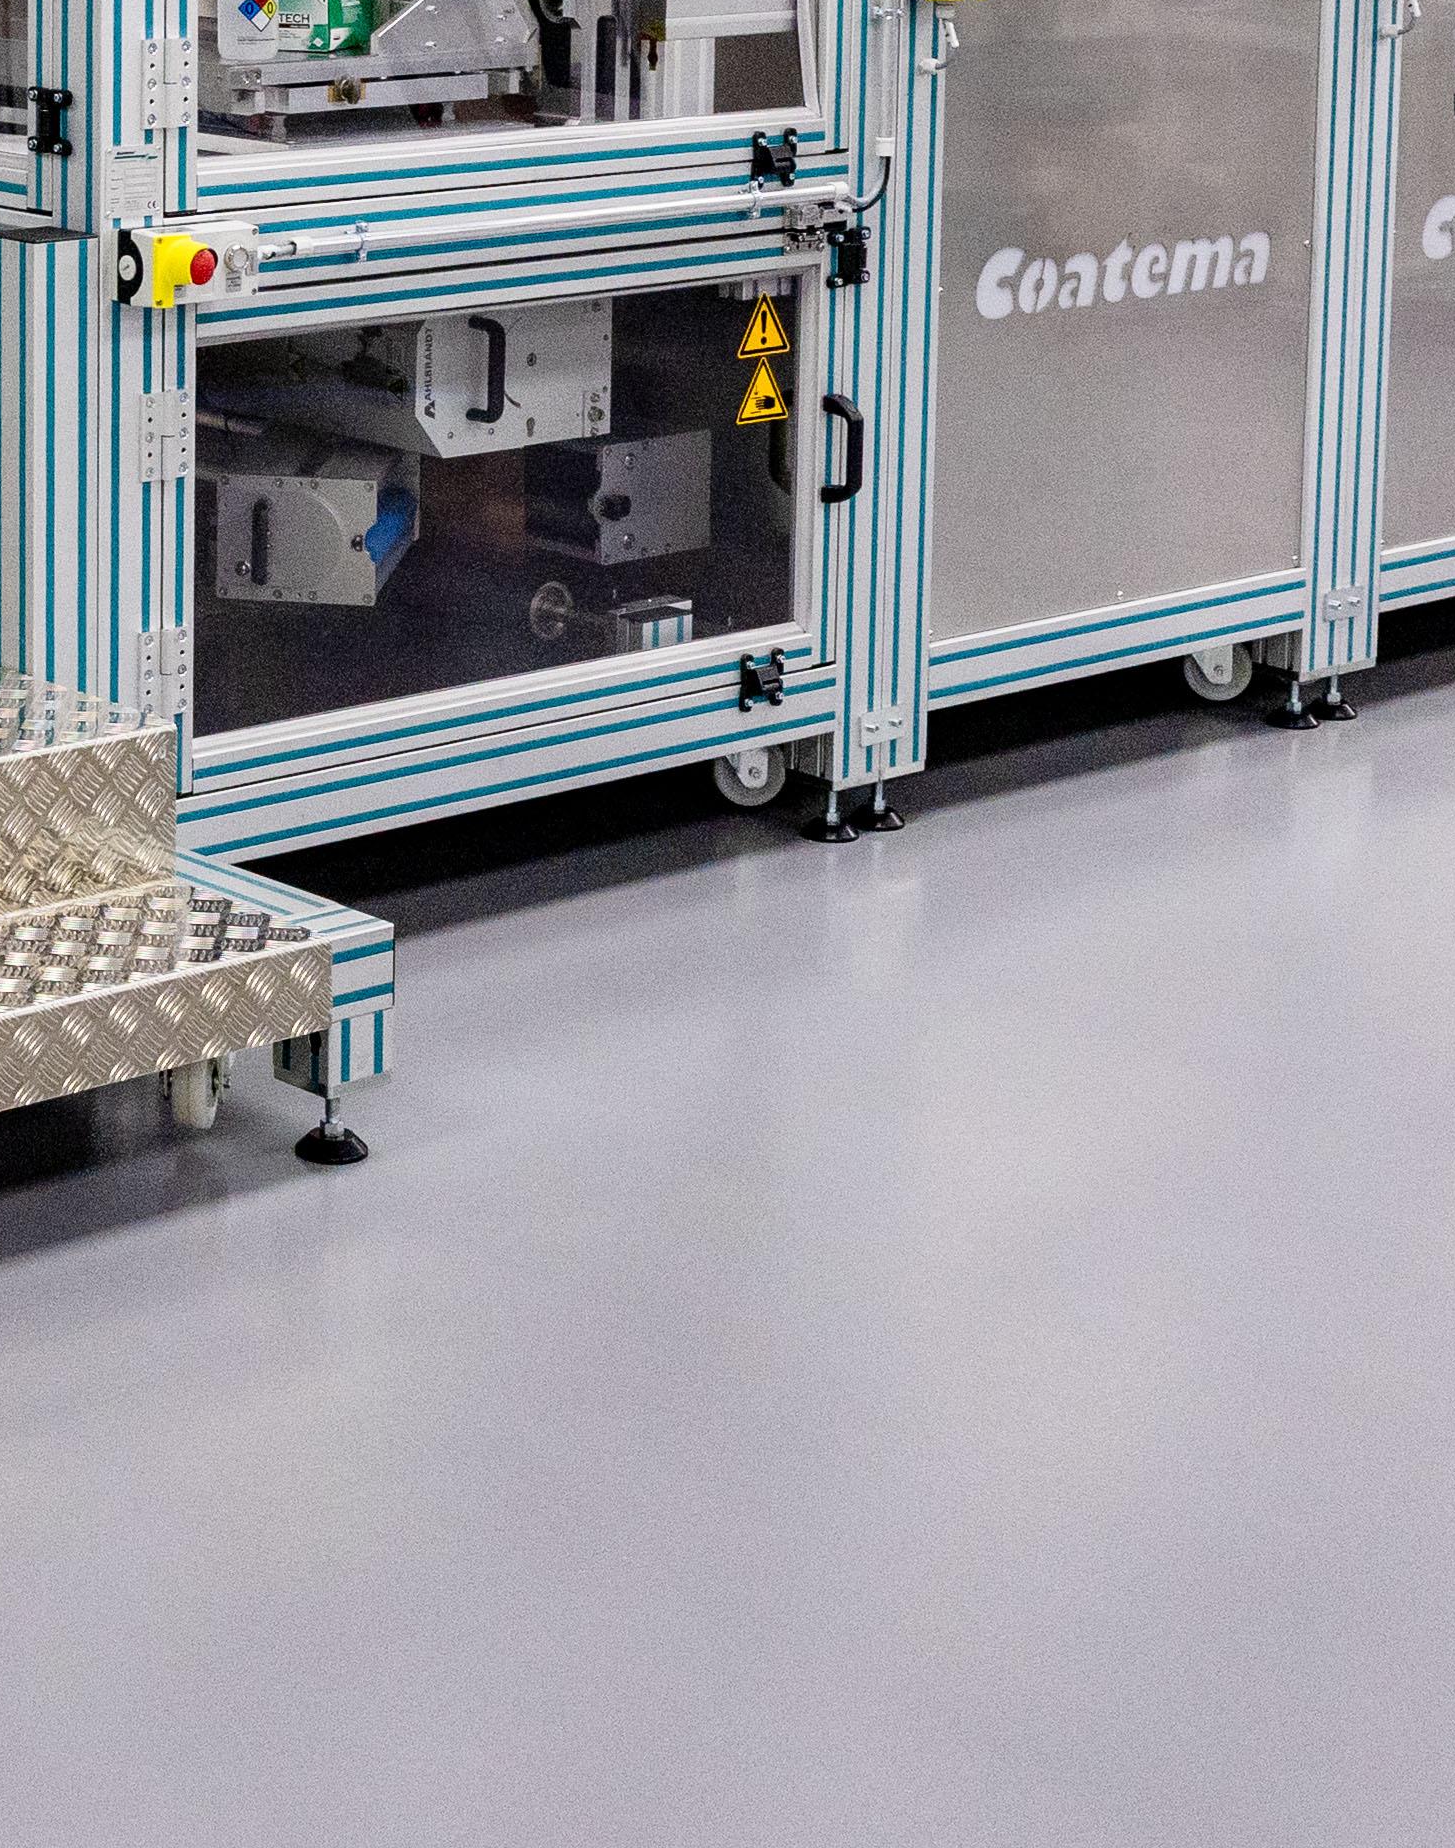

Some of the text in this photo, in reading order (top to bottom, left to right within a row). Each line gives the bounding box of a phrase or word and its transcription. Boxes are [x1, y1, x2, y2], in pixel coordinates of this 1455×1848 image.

[246, 2, 254, 14] 0
[267, 2, 274, 13] 0
[279, 13, 310, 23] TECH
[976, 232, 1271, 320] Coatema
